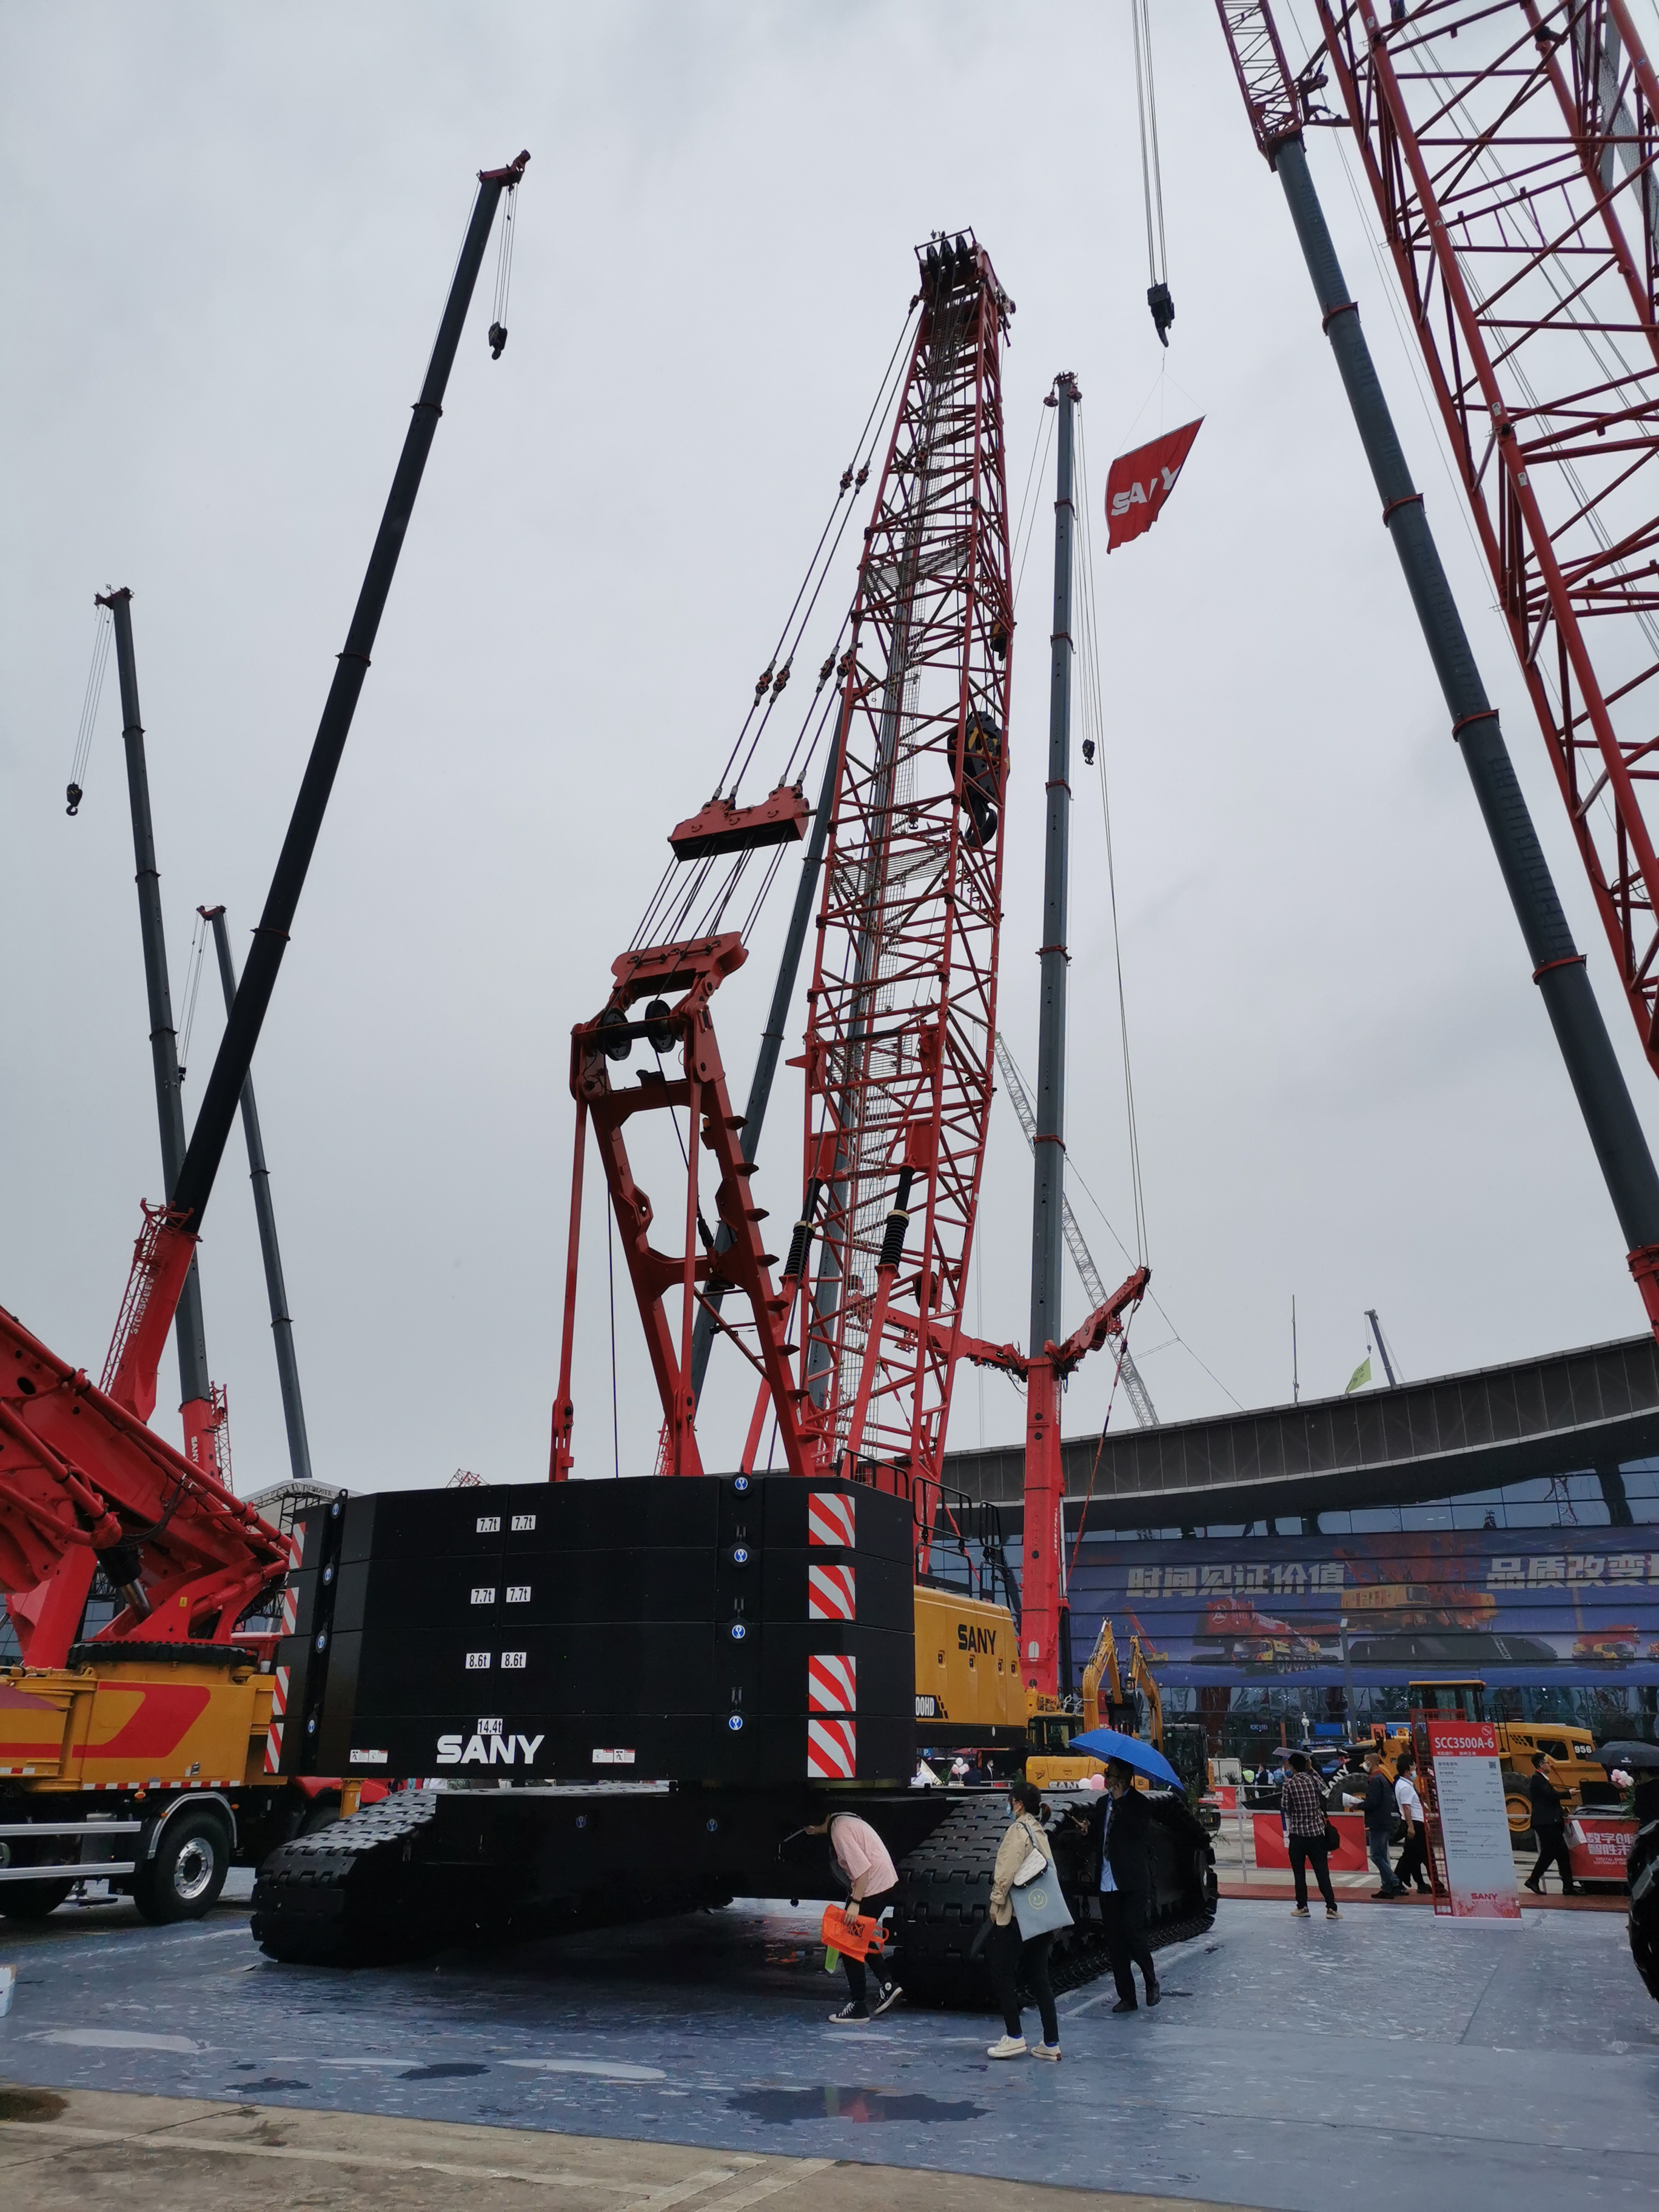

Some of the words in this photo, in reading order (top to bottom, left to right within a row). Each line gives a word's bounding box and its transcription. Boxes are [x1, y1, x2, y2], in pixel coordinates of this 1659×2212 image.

[1111, 466, 1182, 515] SAY
[480, 1518, 497, 1531] 7.7t
[515, 1517, 532, 1529] 7.7t
[1486, 1553, 1659, 1589] 品质改变
[1126, 1562, 1347, 1598] 时间见证价值
[475, 1589, 492, 1603] 7.7t
[510, 1587, 528, 1601] 7.7t
[957, 1624, 997, 1655] SANY
[469, 1654, 487, 1667] 8.6t
[504, 1654, 523, 1667] 8.6t
[478, 1720, 502, 1734] 14.4t
[436, 1735, 545, 1764] SANY
[1434, 1737, 1495, 1749] SCC3500A-6
[1574, 1745, 1592, 1754] 956
[1048, 1781, 1080, 1789] SAN
[1321, 1763, 1349, 1799] SANY
